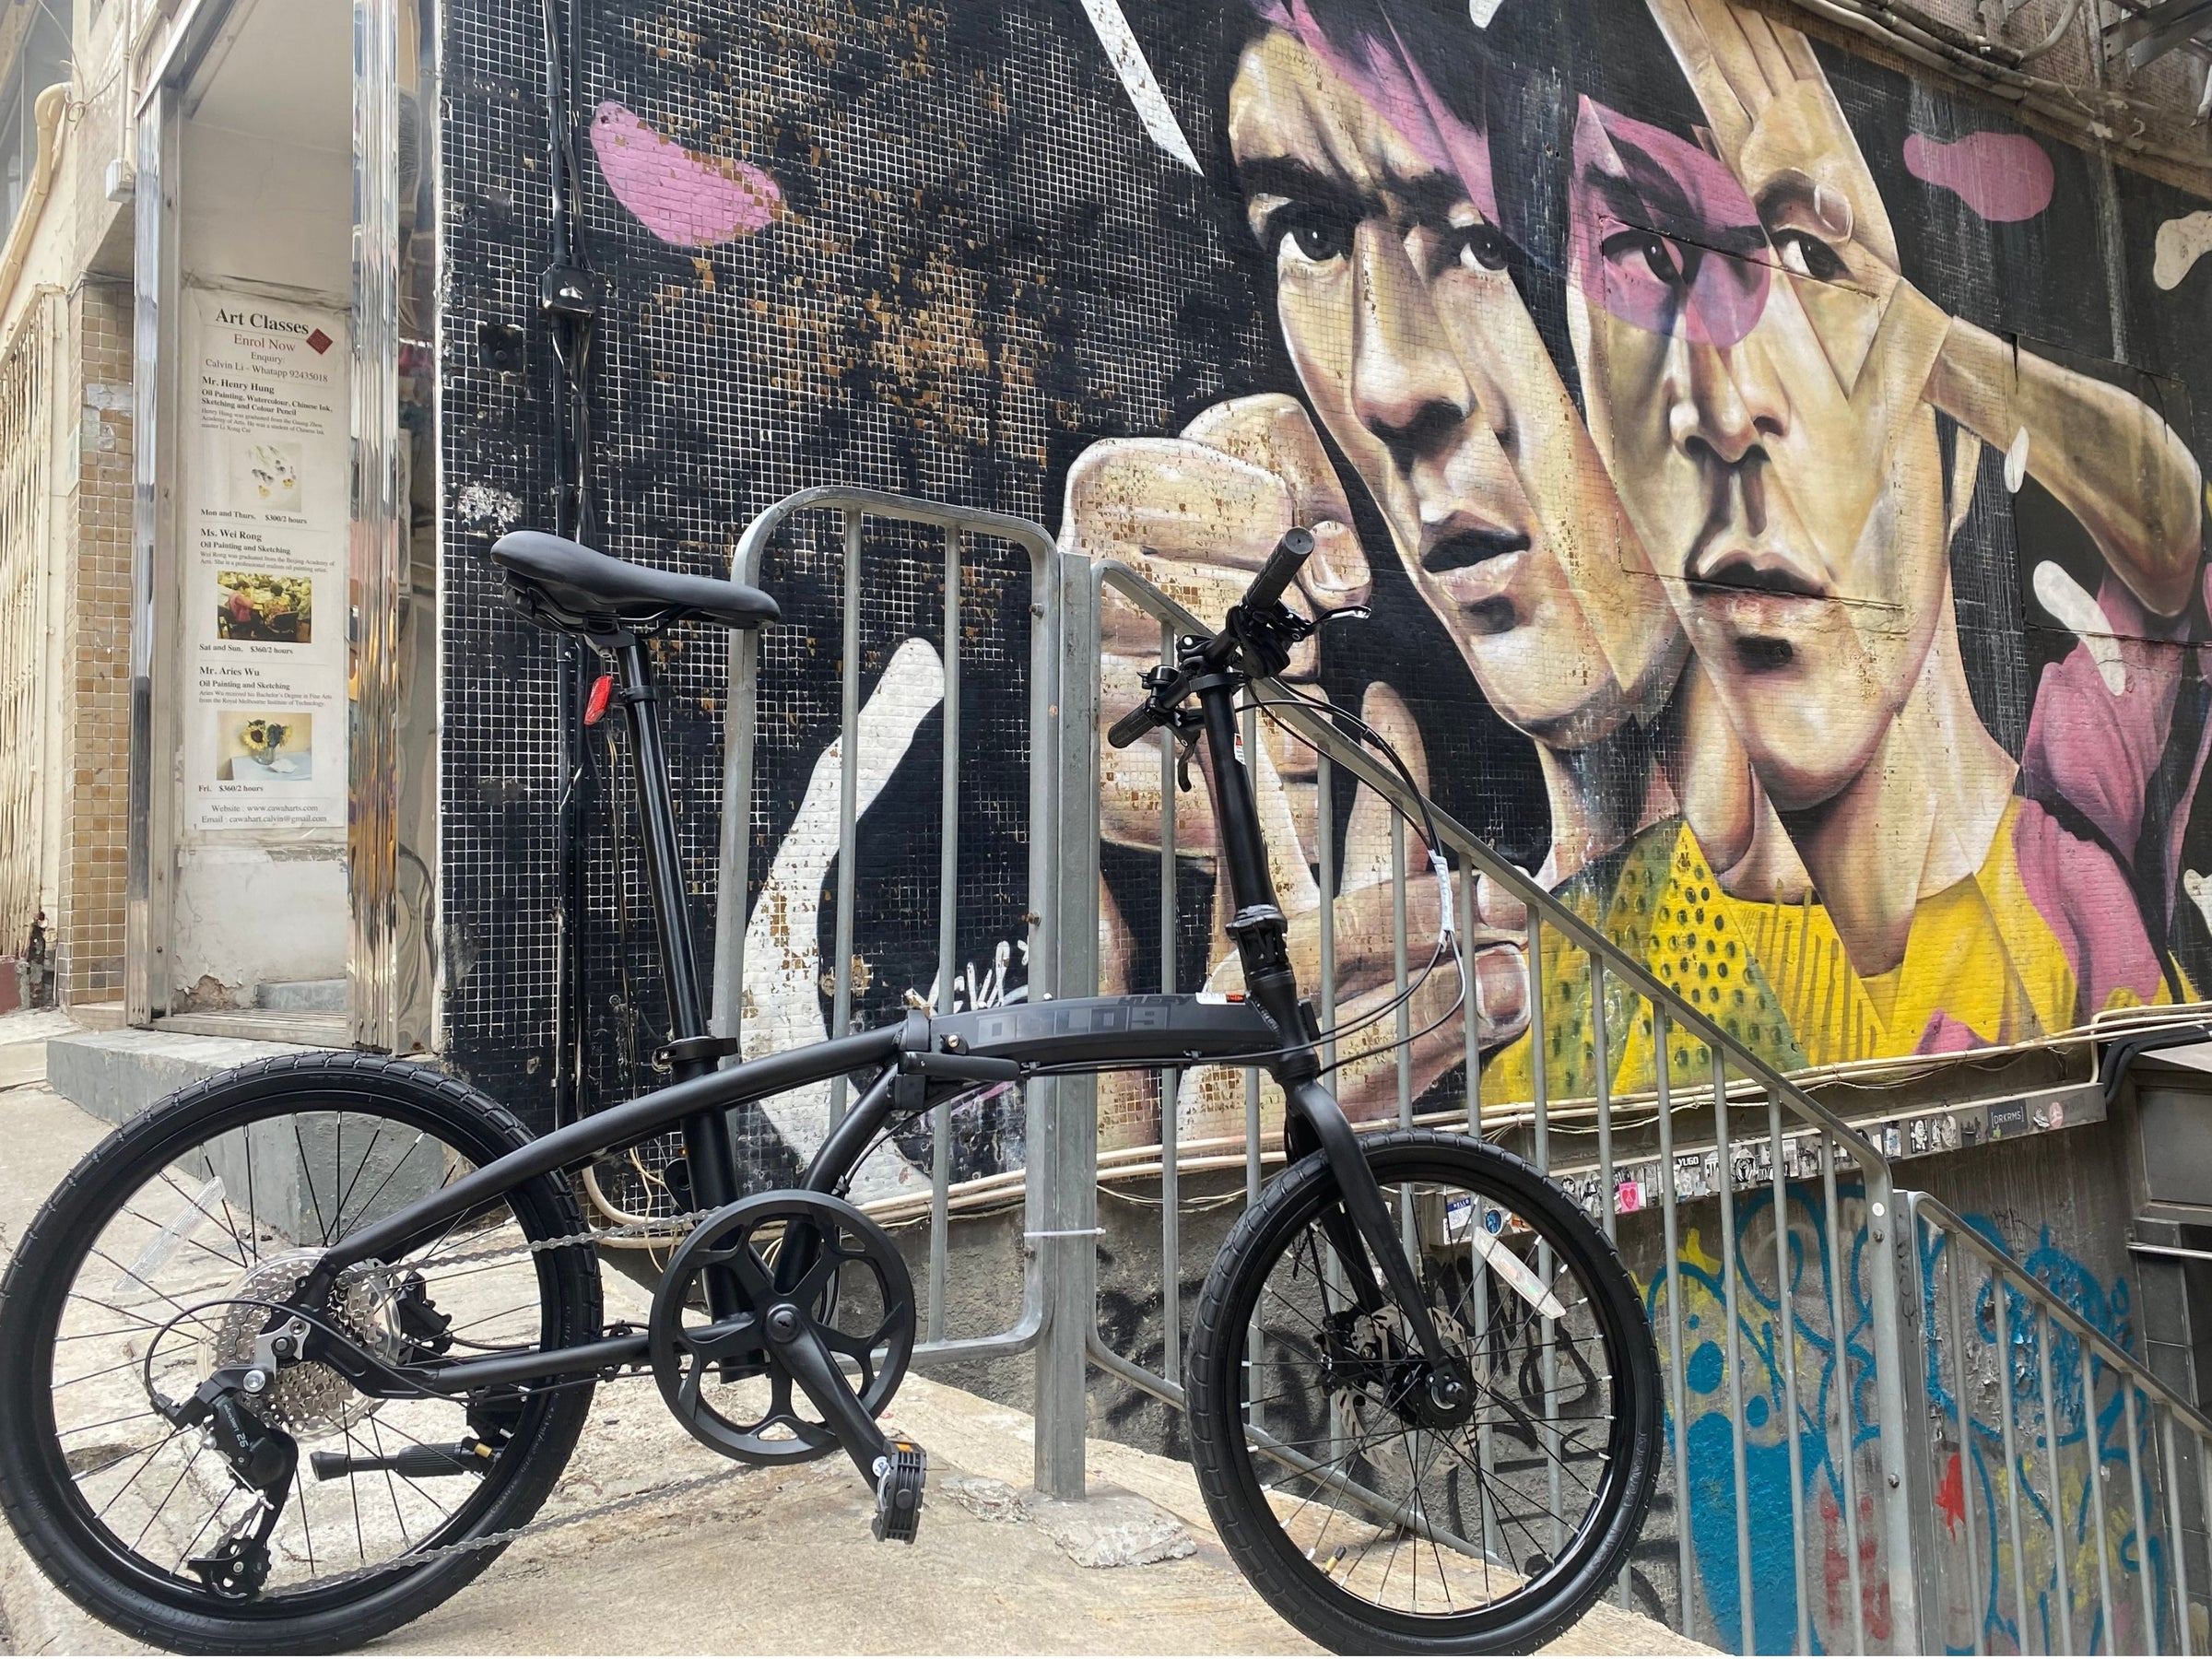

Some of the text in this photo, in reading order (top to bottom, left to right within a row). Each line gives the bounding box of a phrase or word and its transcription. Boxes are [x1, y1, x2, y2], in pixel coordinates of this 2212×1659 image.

[216, 308, 309, 335] Art Classes
[234, 334, 295, 351] Enrol Now
[206, 359, 232, 369] Calvin
[235, 362, 243, 371] Li
[253, 365, 288, 378] Whatapp
[202, 376, 275, 394] Mr. Henry Hung
[201, 397, 235, 409] Sketching
[251, 404, 275, 413] Colour
[276, 407, 297, 416] Pencil
[291, 401, 318, 409] Chinese
[201, 527, 262, 542] Ms. Wei Rong
[214, 542, 241, 551] Painting
[258, 546, 291, 555] Sketching
[199, 666, 260, 677] Mr. Aries Wu
[212, 680, 241, 689] Painting
[256, 682, 290, 690] Sketching
[1677, 1156, 1700, 1167] YUGO
